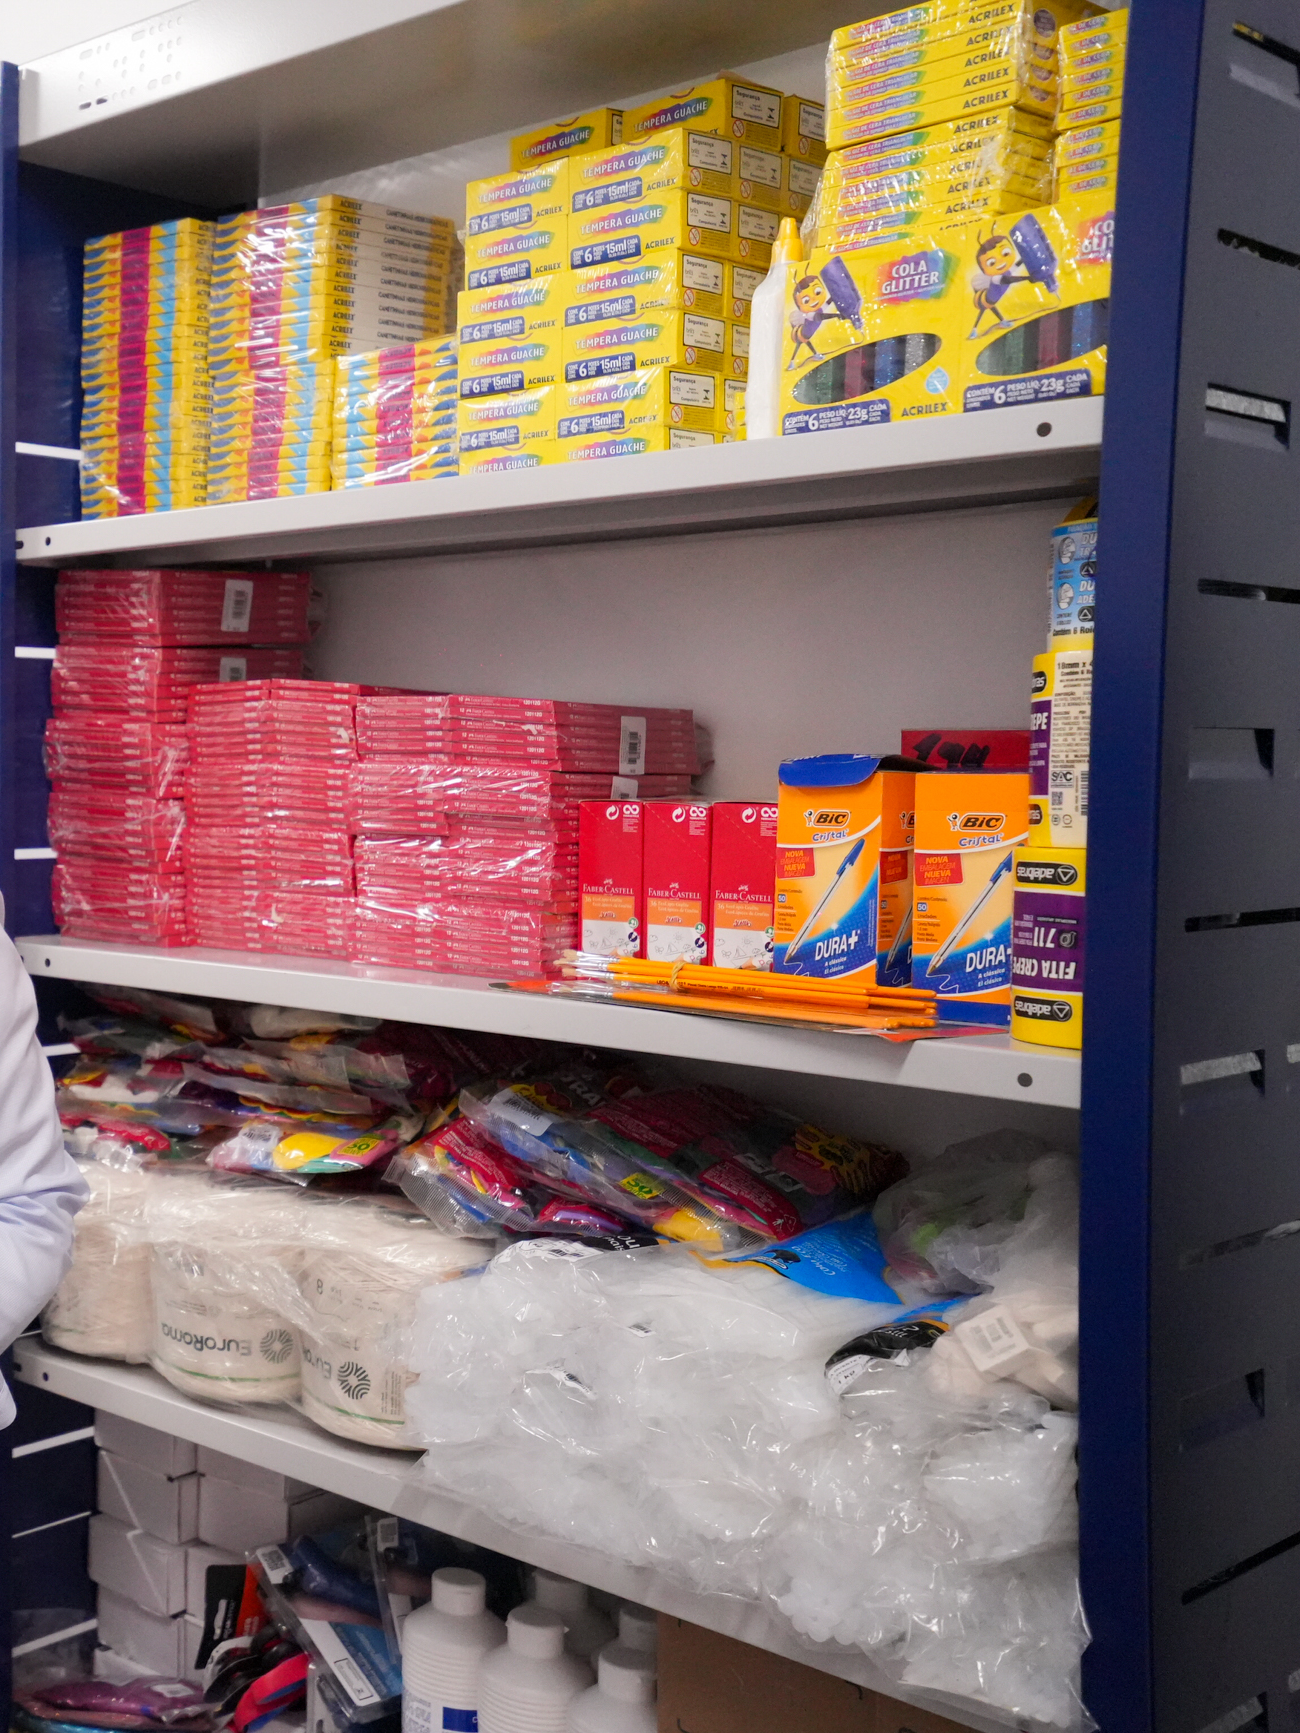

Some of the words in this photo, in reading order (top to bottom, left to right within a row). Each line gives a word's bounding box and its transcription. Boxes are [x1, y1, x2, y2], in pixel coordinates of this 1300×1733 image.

[969, 3, 1014, 24] ACRILEX
[963, 66, 1010, 88] ACRILEX
[962, 88, 1009, 109] ACRILEX
[633, 111, 672, 133] TEMPERA
[674, 101, 708, 119] GUACHE
[521, 138, 557, 160] TEMPERA
[559, 130, 590, 147] GUACHE
[583, 160, 626, 178] TEMPERA
[628, 149, 665, 167] GUACHE
[478, 187, 517, 203] TEMPERA
[519, 179, 552, 194] GUACHE
[585, 190, 594, 205] 6
[607, 182, 629, 198] 15ml
[646, 177, 676, 192] ACRILEX
[481, 217, 488, 230] 6
[500, 207, 520, 221] 15ml
[536, 206, 563, 217] ACRILEX
[580, 219, 623, 235] TEMPERA
[625, 208, 662, 225] GUACHE
[477, 243, 514, 258] TEMPERA
[517, 235, 550, 250] GUACHE
[585, 248, 592, 262] 6
[605, 239, 628, 254] 15ml
[645, 237, 675, 249] ACRILEX
[481, 272, 487, 285] 6
[499, 262, 519, 277] 15ml
[535, 262, 562, 273] ACRILEX
[892, 260, 927, 278] COLA
[576, 278, 618, 294] TEMPERA
[621, 270, 658, 285] GUACHE
[882, 271, 939, 294] GLITTER
[470, 300, 508, 314] TEMPERA
[511, 292, 545, 308] GUACHE
[579, 307, 586, 321] 6
[600, 298, 622, 313] 15ml
[473, 326, 480, 339] 6
[492, 320, 512, 334] 15ml
[529, 320, 556, 330] ACRILEX
[575, 335, 618, 349] TEMPERA
[620, 327, 658, 342] GUACHE
[470, 354, 508, 367] TEMPERA
[511, 347, 544, 361] GUACHE
[579, 362, 587, 377] 6
[600, 356, 622, 371] 15ml
[640, 356, 670, 367] ACRILEX
[473, 379, 480, 392] 6
[492, 374, 512, 388] 15ml
[528, 375, 555, 385] ACRILEX
[967, 387, 996, 398] CONTÉM
[994, 385, 1006, 404] 6
[1007, 383, 1025, 391] PESO
[1040, 377, 1065, 393] 23g
[1066, 373, 1088, 382] CADA
[568, 392, 608, 406] TEMPERA
[611, 386, 646, 400] GUACHE
[468, 407, 504, 419] TEMPERA
[506, 402, 538, 415] GUACHE
[785, 415, 809, 426] CONTÉM
[808, 412, 819, 431] 6
[819, 410, 836, 419] PESO
[848, 405, 868, 422] 23g
[869, 403, 887, 412] CADA
[901, 402, 948, 418] ACRILEX
[570, 419, 578, 433] 6
[590, 413, 612, 427] 15ml
[471, 433, 478, 447] 6
[488, 428, 508, 442] 15ml
[523, 430, 549, 440] ACRILEX
[567, 447, 607, 460] TEMPERA
[609, 442, 645, 455] GUACHE
[506, 458, 538, 470] GUACHE
[1052, 772, 1073, 782] SAC
[785, 850, 804, 858] NOVA
[926, 856, 949, 864] NOVA
[784, 863, 806, 871] NUEVA
[924, 870, 951, 878] NUEVA
[1017, 866, 1055, 882] adebras
[917, 903, 927, 911] 50
[814, 929, 860, 961] DURA+
[1033, 927, 1057, 948] 711
[1042, 959, 1076, 980] FITA
[1015, 1000, 1052, 1016] adebras
[161, 1321, 252, 1356] EuroRoma
